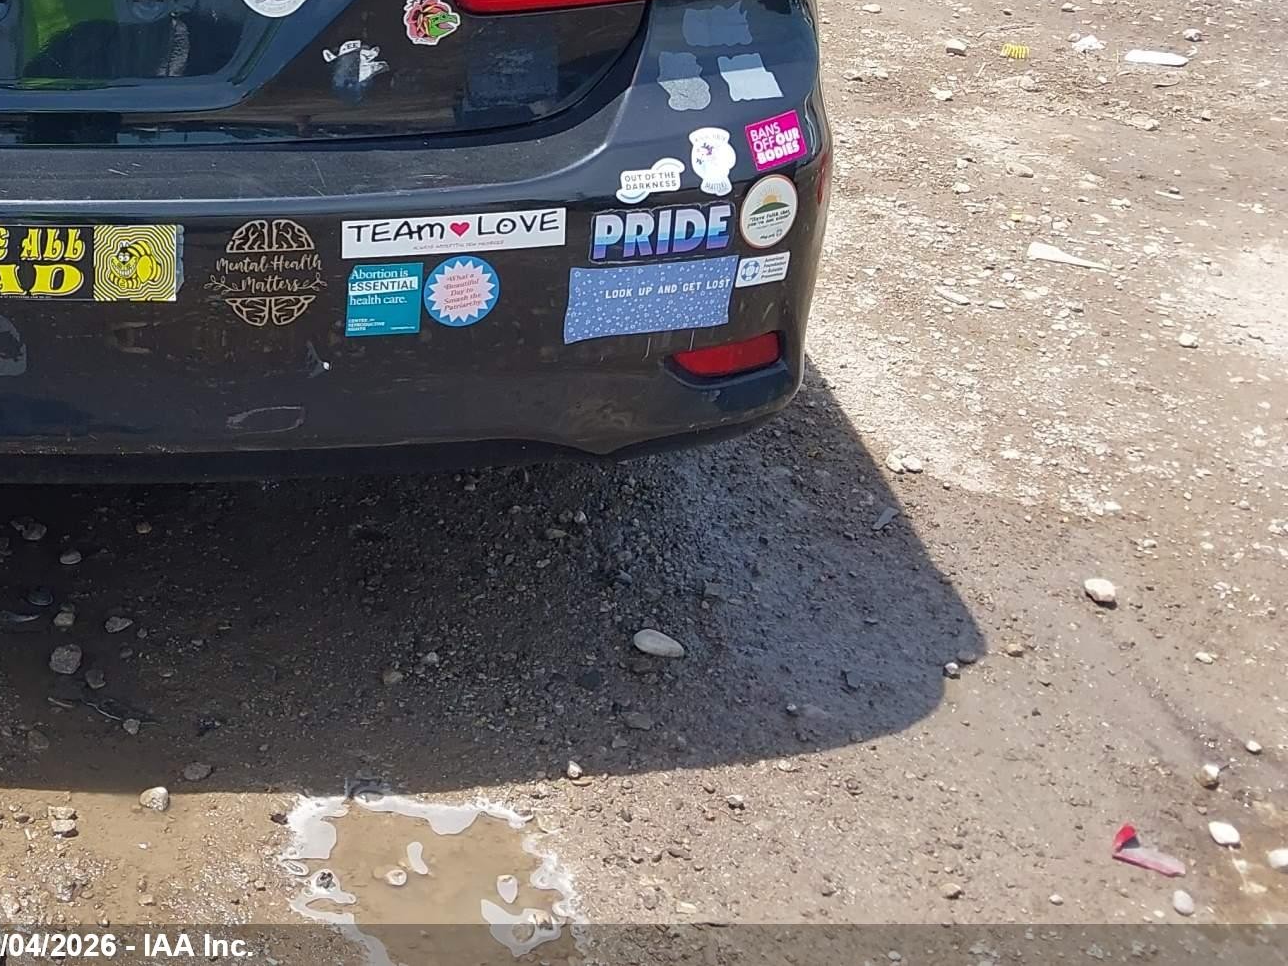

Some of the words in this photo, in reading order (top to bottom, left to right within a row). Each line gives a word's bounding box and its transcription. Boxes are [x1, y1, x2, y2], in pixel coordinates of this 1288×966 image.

[750, 122, 781, 142] BANS
[753, 136, 775, 153] OFF
[775, 127, 800, 145] OUR
[757, 140, 800, 164] BODIES
[624, 174, 642, 182] OUT
[625, 180, 677, 191] DARKNESS
[478, 211, 560, 235] LOVE
[593, 205, 731, 259] PRIDE
[216, 256, 267, 274] Mental
[270, 254, 322, 272] Health
[351, 269, 398, 280] Abortion
[400, 268, 409, 277] is
[447, 274, 468, 282] What
[241, 275, 300, 293] Matters
[350, 280, 416, 292] ESSENTIAL
[444, 279, 479, 290] Beautiful
[605, 288, 633, 299] LOOK
[638, 286, 652, 296] UP
[657, 284, 678, 294] AND
[682, 281, 701, 291] GET
[706, 278, 731, 290] LOST
[350, 294, 381, 305] health
[383, 296, 408, 304] care.
[444, 295, 468, 304] Smash
